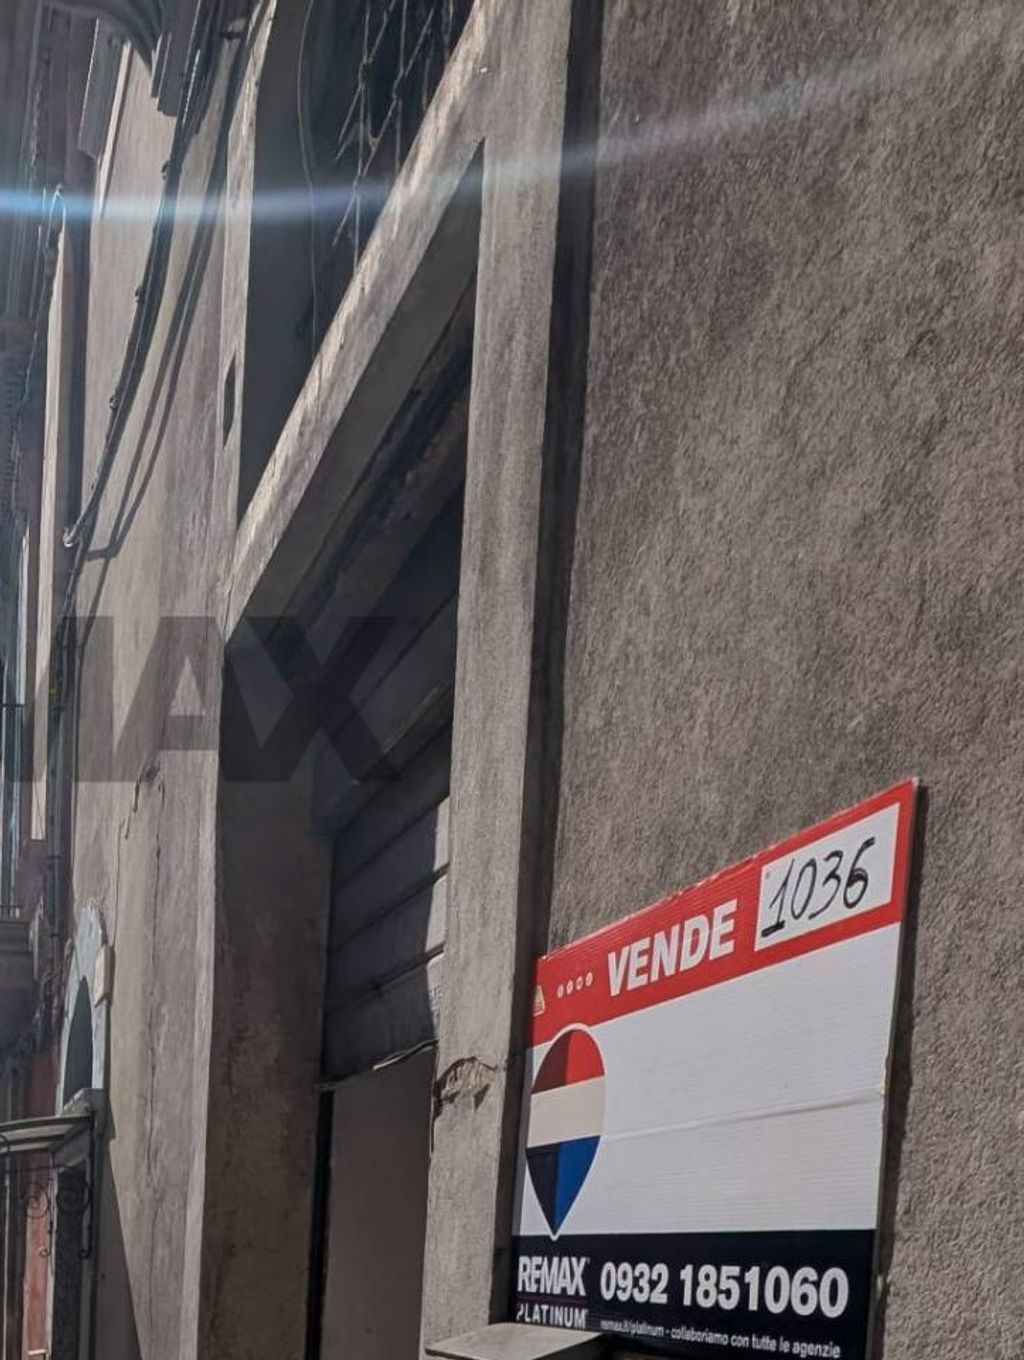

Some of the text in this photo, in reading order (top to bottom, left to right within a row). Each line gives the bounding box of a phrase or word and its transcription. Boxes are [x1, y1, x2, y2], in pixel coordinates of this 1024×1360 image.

[761, 836, 876, 938] 1036
[607, 898, 738, 996] VENDE
[517, 1255, 588, 1297] REMAX
[600, 1261, 850, 1319] 0932 1851060
[516, 1302, 587, 1330] PLATINUM
[730, 1334, 750, 1349] con
[752, 1333, 777, 1352] tutte
[779, 1335, 790, 1353] le
[792, 1341, 842, 1359] agenzie
